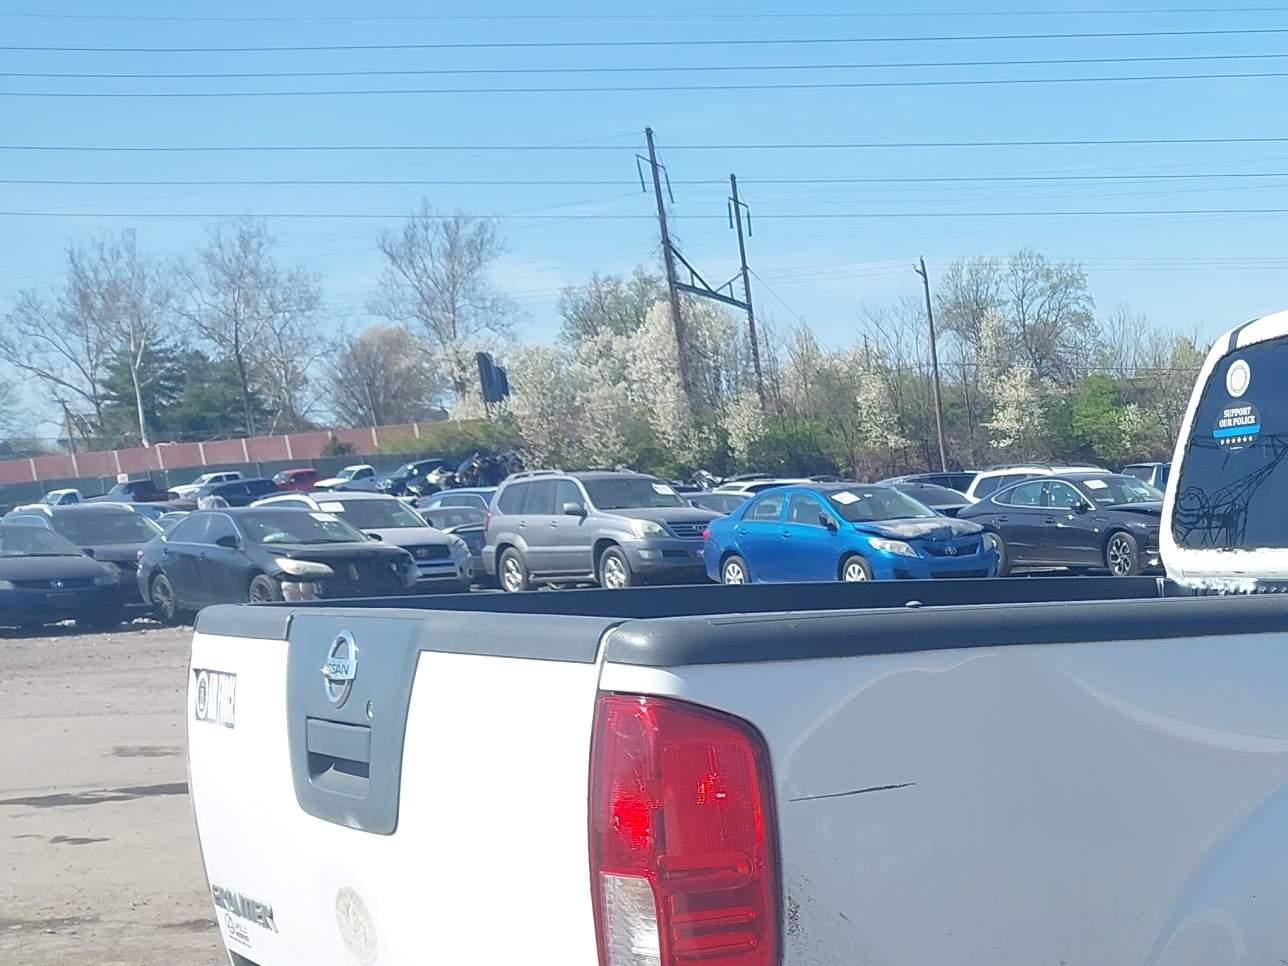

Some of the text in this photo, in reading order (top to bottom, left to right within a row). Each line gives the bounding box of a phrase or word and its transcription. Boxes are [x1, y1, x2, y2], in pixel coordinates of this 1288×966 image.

[1223, 406, 1252, 418] SUPPORT
[1219, 415, 1256, 428] OUR POLICE
